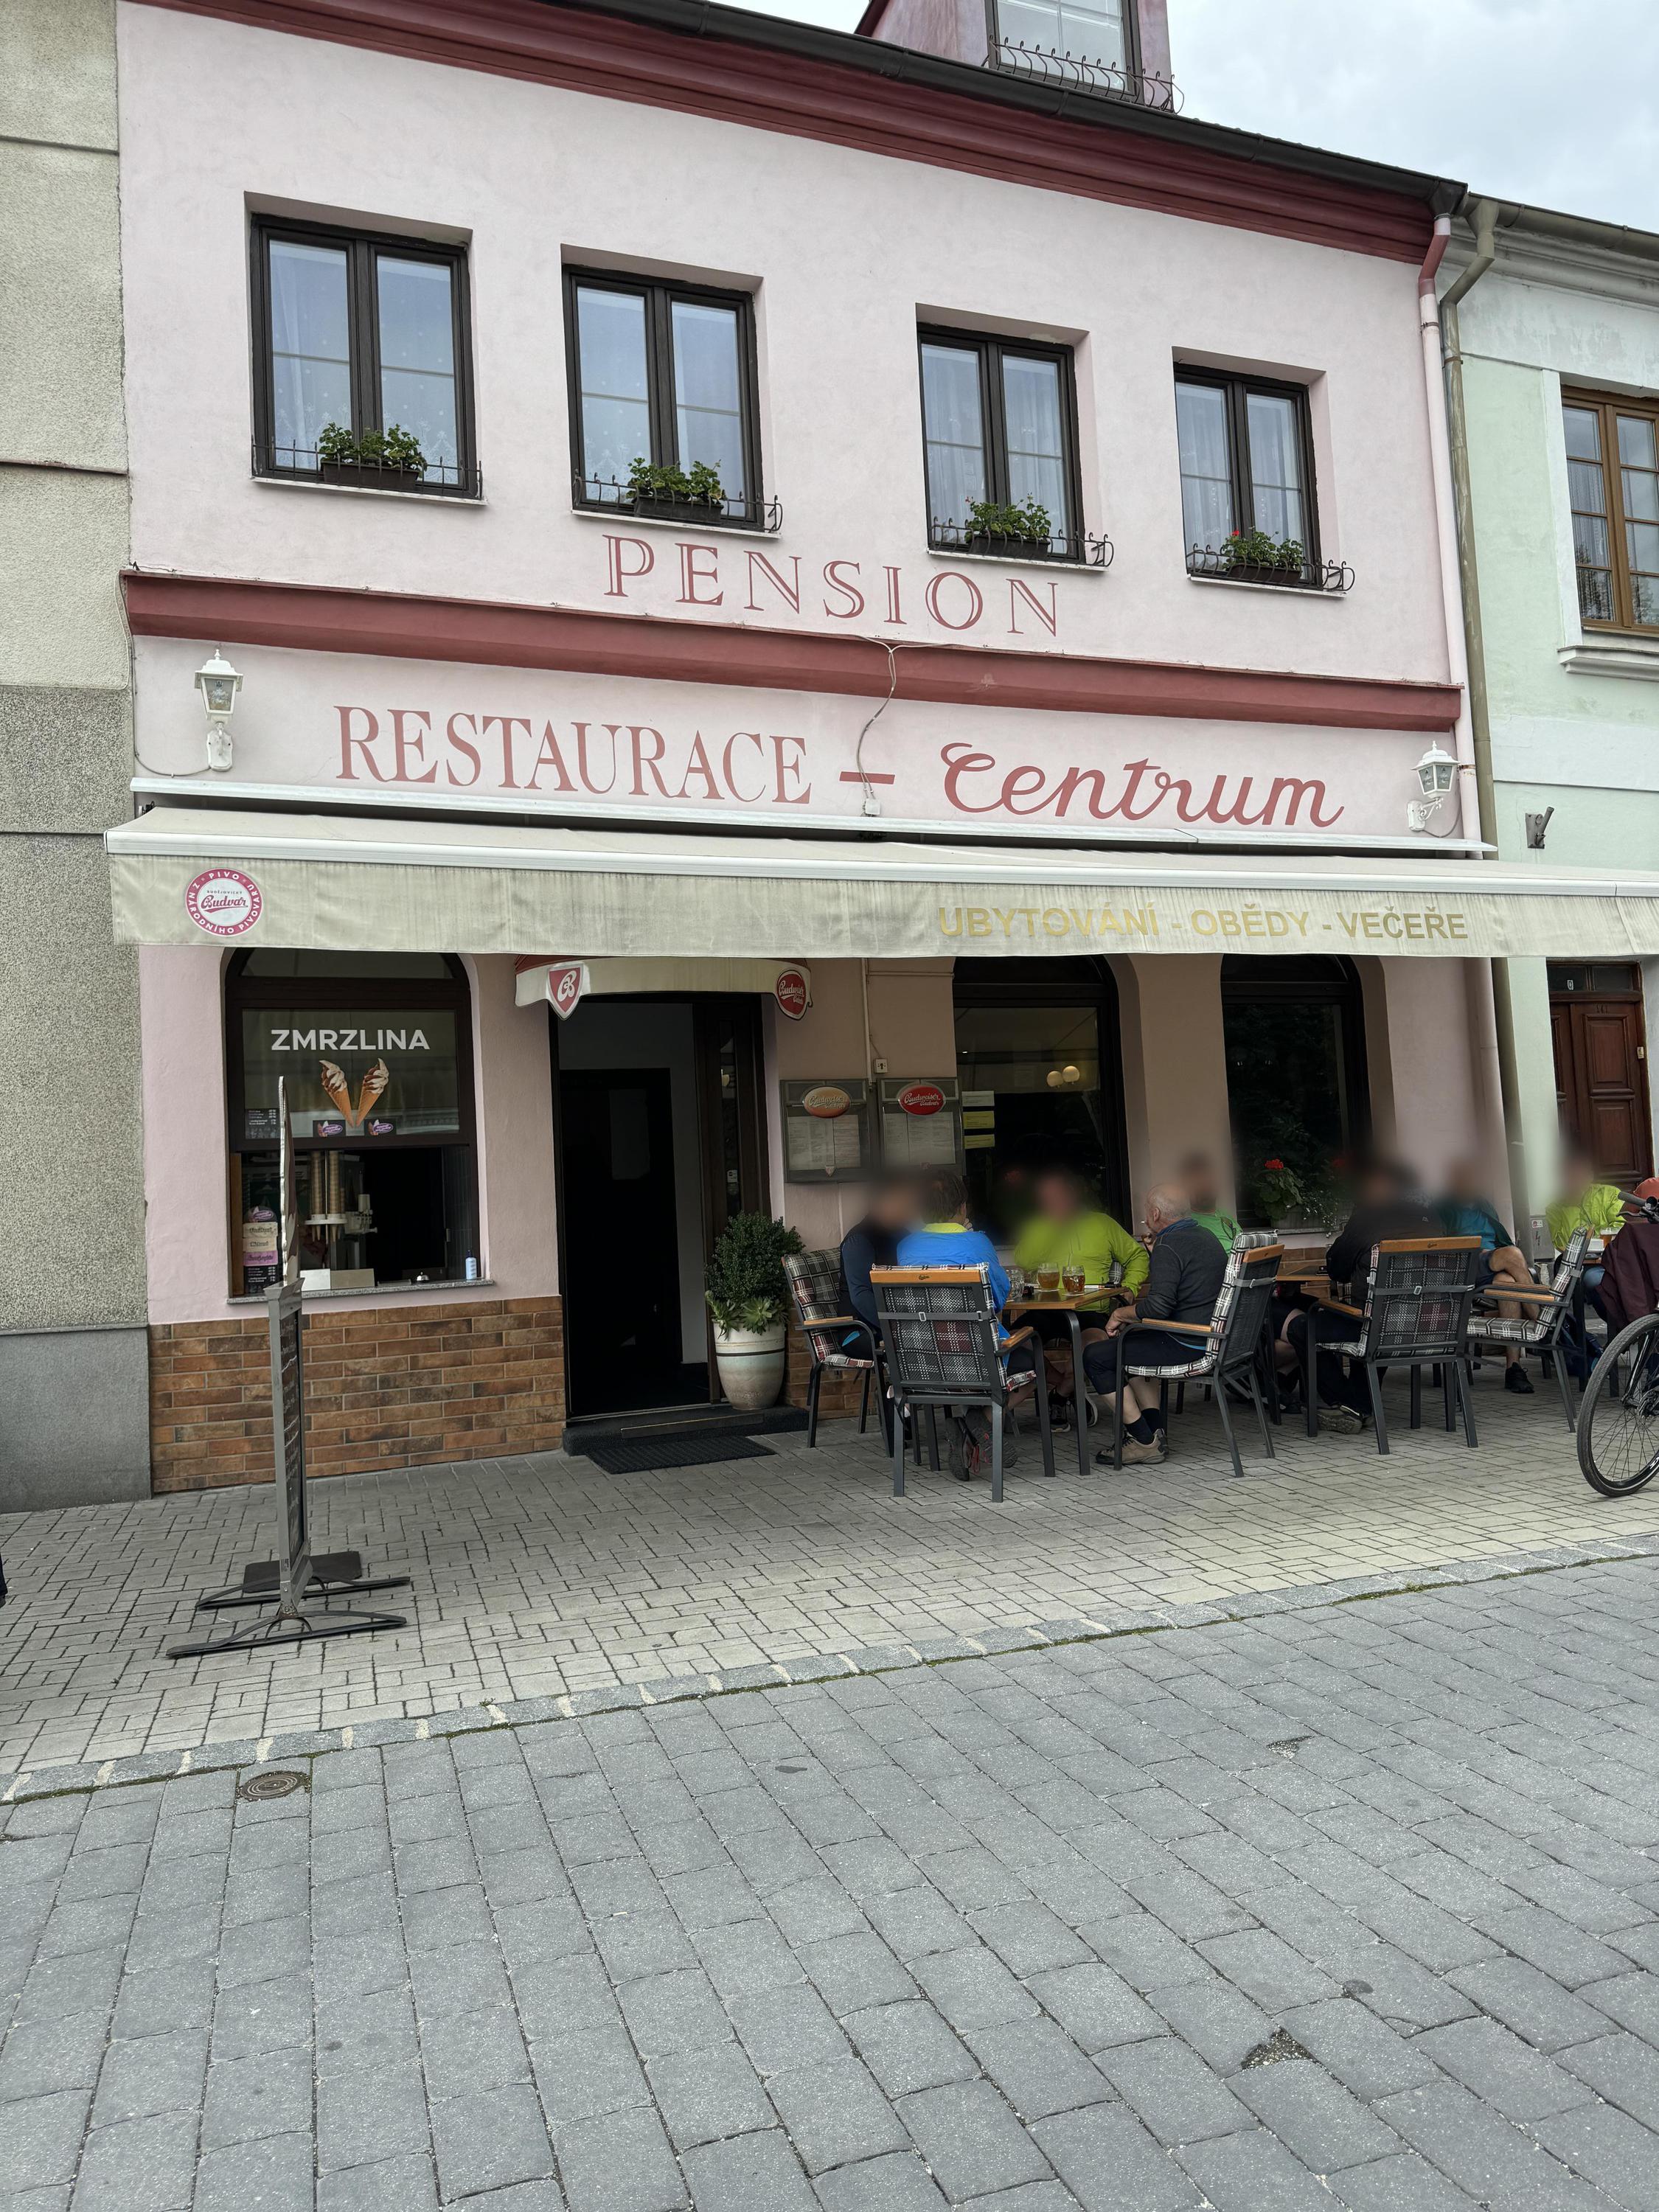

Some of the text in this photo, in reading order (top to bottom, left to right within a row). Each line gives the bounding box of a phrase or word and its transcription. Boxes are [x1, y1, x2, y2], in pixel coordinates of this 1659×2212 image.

[602, 534, 1058, 637] PENSION
[333, 705, 812, 804] RESTAURACE
[940, 742, 1344, 828] Centrum
[209, 871, 240, 880] PIVO
[201, 894, 247, 909] Budvar
[239, 884, 260, 931] PIVOVARU
[939, 901, 1160, 938] UBYTOVÁNÍ
[1190, 902, 1310, 937] OBĚDY
[1336, 905, 1469, 939] VEČEŘE
[271, 1029, 431, 1051] ZMRZLINA
